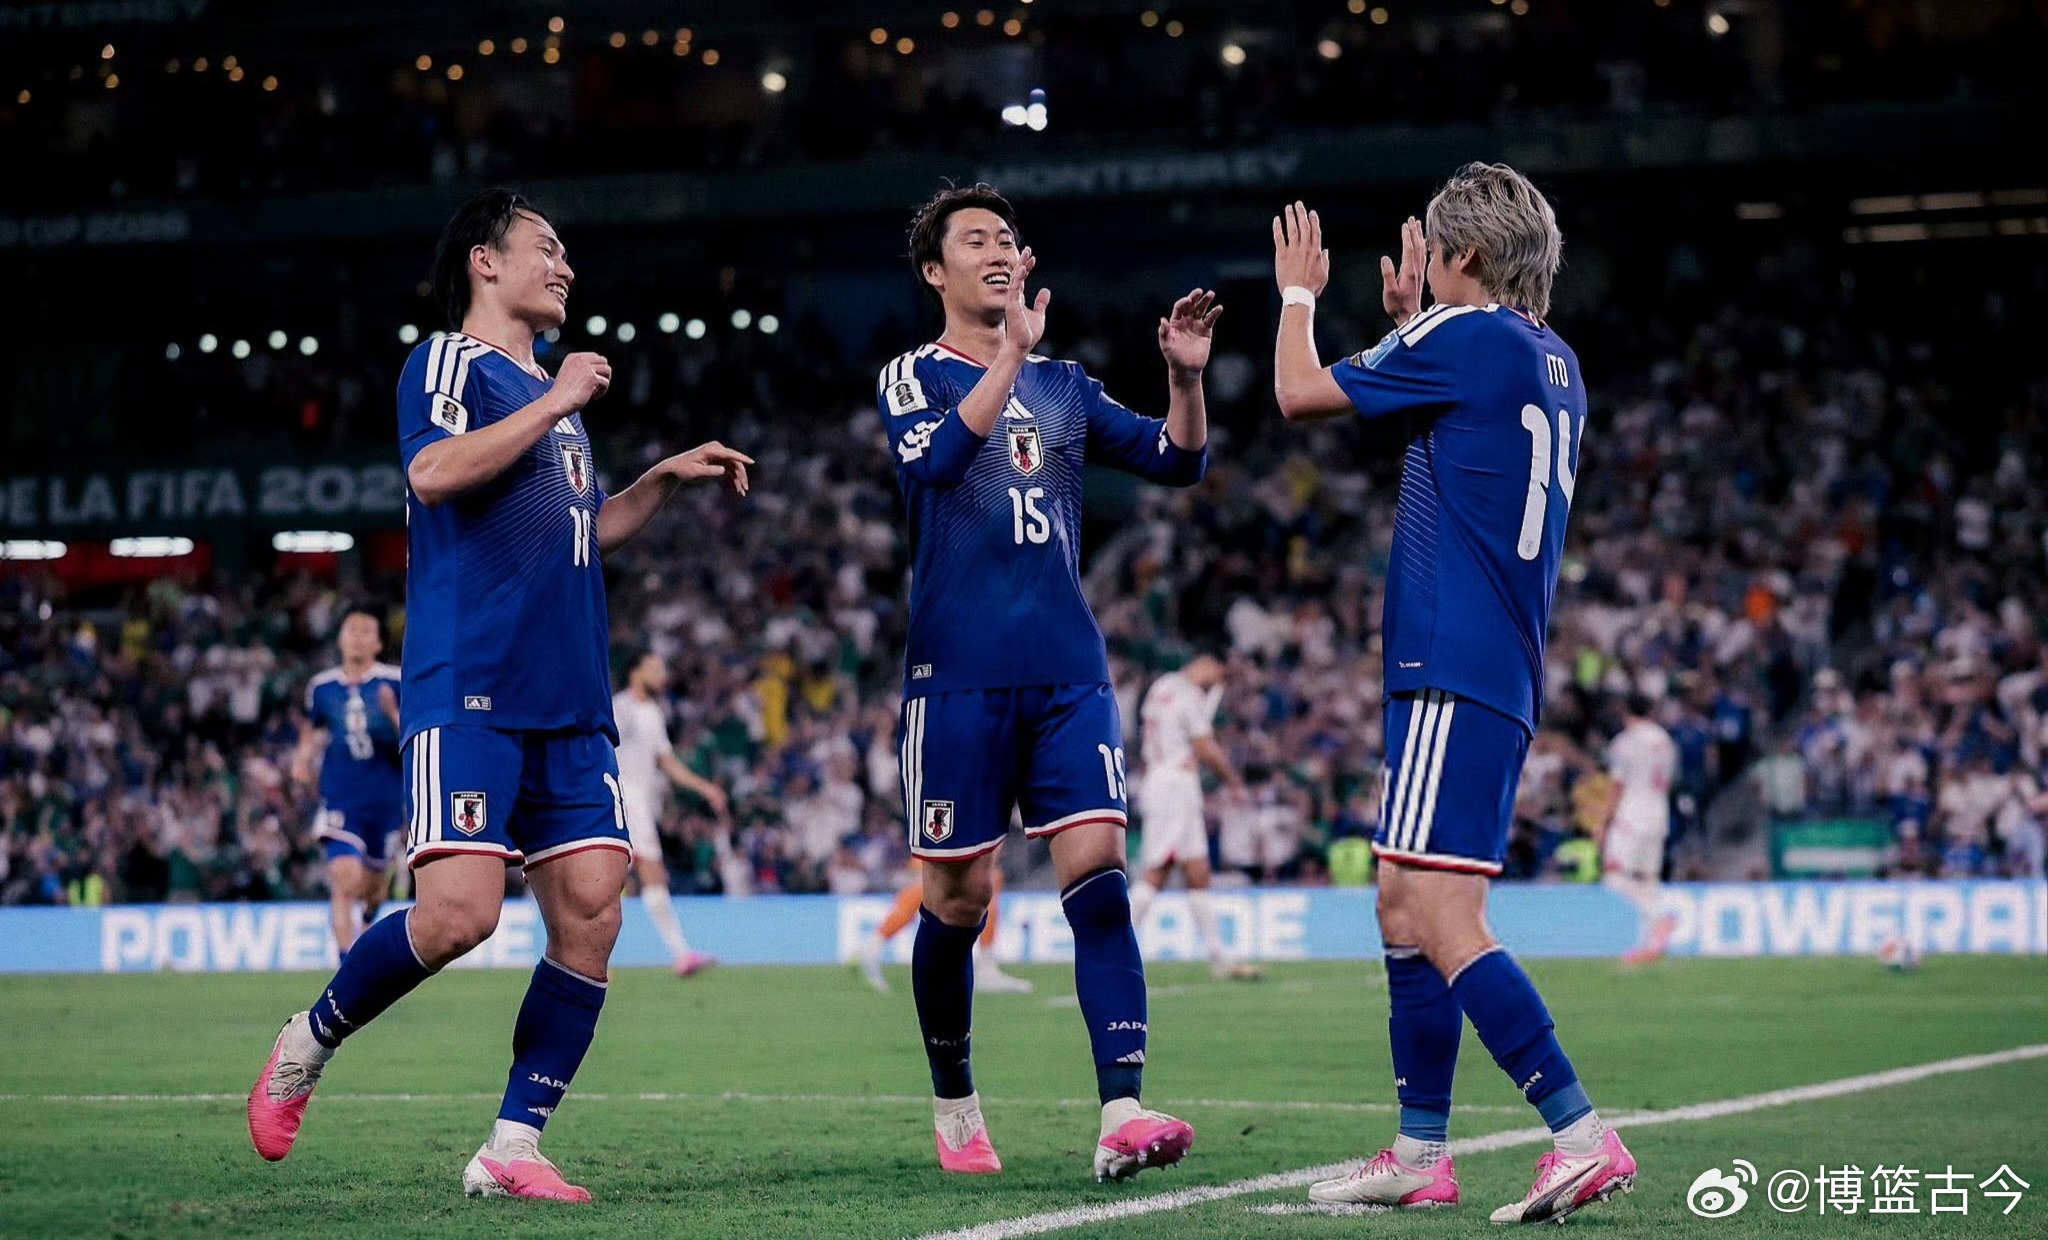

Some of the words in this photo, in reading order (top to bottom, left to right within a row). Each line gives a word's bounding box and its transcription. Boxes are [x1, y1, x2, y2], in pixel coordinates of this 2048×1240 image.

[1546, 353, 1568, 388] ITO
[48, 474, 117, 525] LA
[127, 469, 246, 522] FIFA
[1008, 487, 1050, 545] 15
